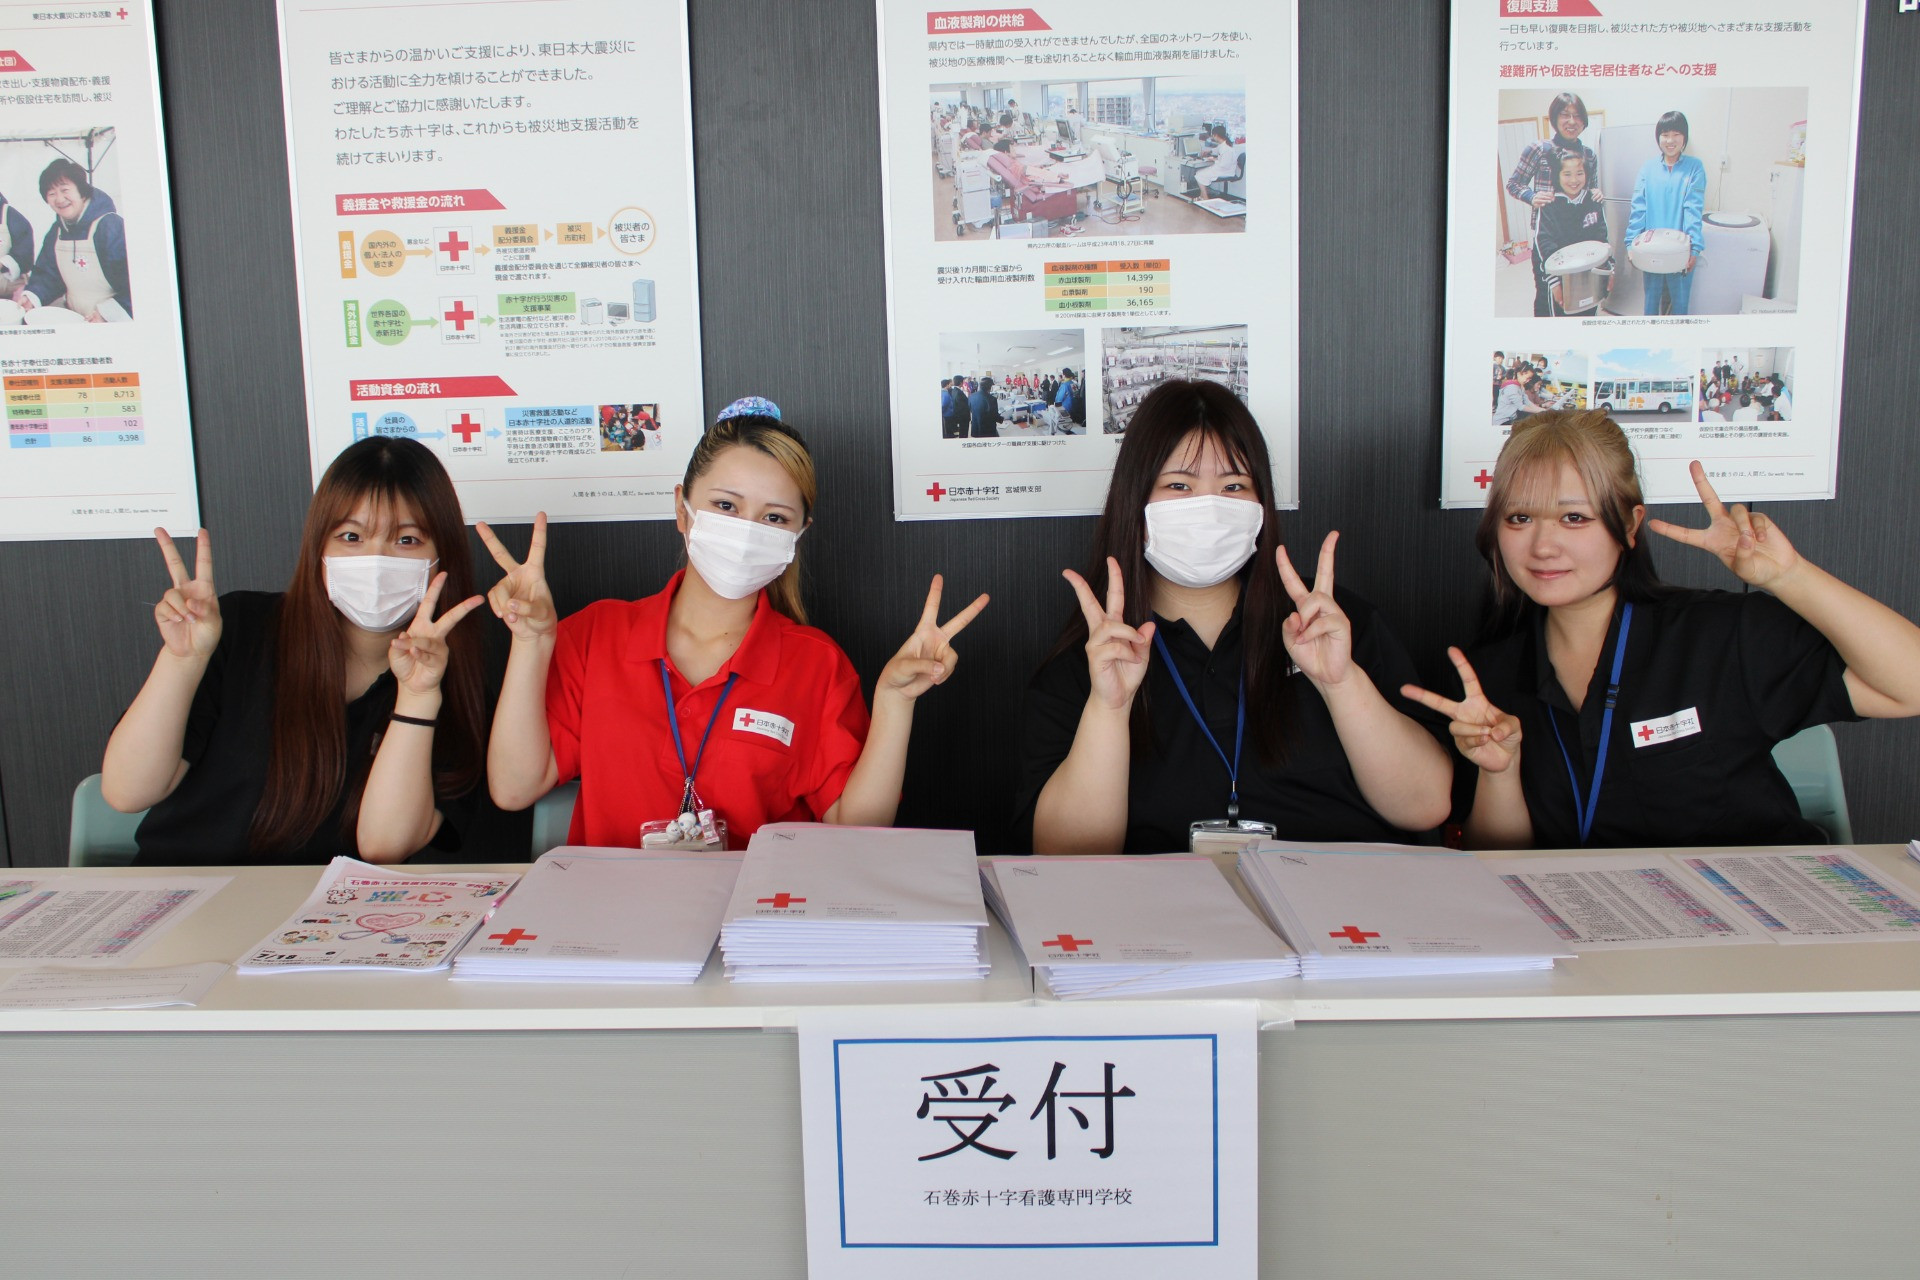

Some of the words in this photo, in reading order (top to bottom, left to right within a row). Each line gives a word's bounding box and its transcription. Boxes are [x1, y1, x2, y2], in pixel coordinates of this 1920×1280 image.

[1507, 0, 1558, 13] 復興支援
[32, 11, 112, 21] 東日本大震災における活動
[934, 14, 1025, 30] 血液製剤の供給
[1500, 21, 1812, 35] 一日も早い復興を目指し、被災された方や被災地へさまざまな支援活動を
[928, 31, 1253, 52] 県内では一時献血の受入れができませんでしたが、全国のネットワークを使い、
[1500, 41, 1559, 52] 行っています。
[329, 40, 636, 66] 皆さまからの温かいご支援により、東日本大震災に
[929, 49, 1240, 68] 被災地の医療機関へ一度も途切れることなく輸血用血液製剤を届けました。
[1500, 63, 1718, 78] 避難所や仮設住宅居住者などへの支援
[0, 75, 111, 89] き出し・支援物資配布・義援
[331, 68, 594, 90] おける活動に全力を傾けることができました。
[333, 96, 533, 116] ご理解とご協力に感謝いたします。
[335, 116, 640, 141] わたしたち赤十字は、これからも被災地支援活動を
[336, 150, 444, 166] 続けてまいります。
[342, 195, 466, 212] 義援金や救援金の流れ
[614, 222, 650, 232] 被災者の
[620, 234, 646, 243] 皆さま
[937, 274, 1036, 285] 受け入れた輸血用血液製剤数
[1126, 274, 1154, 283] 14,399
[1139, 286, 1154, 294] 190
[1126, 298, 1154, 308] 36,165
[78, 392, 88, 400] 78
[113, 390, 135, 399] 8,713
[356, 382, 442, 397] 活動資金の流れ
[121, 405, 137, 413] 583
[508, 417, 593, 427] 日本赤十字社の人道的活動
[118, 434, 140, 443] 9,398
[948, 486, 1000, 496] 日本赤十字社
[1005, 485, 1042, 494] 宮城県支部
[917, 1061, 1136, 1162] 受付
[923, 1188, 1134, 1207] 石巻赤十字看護専門学校
